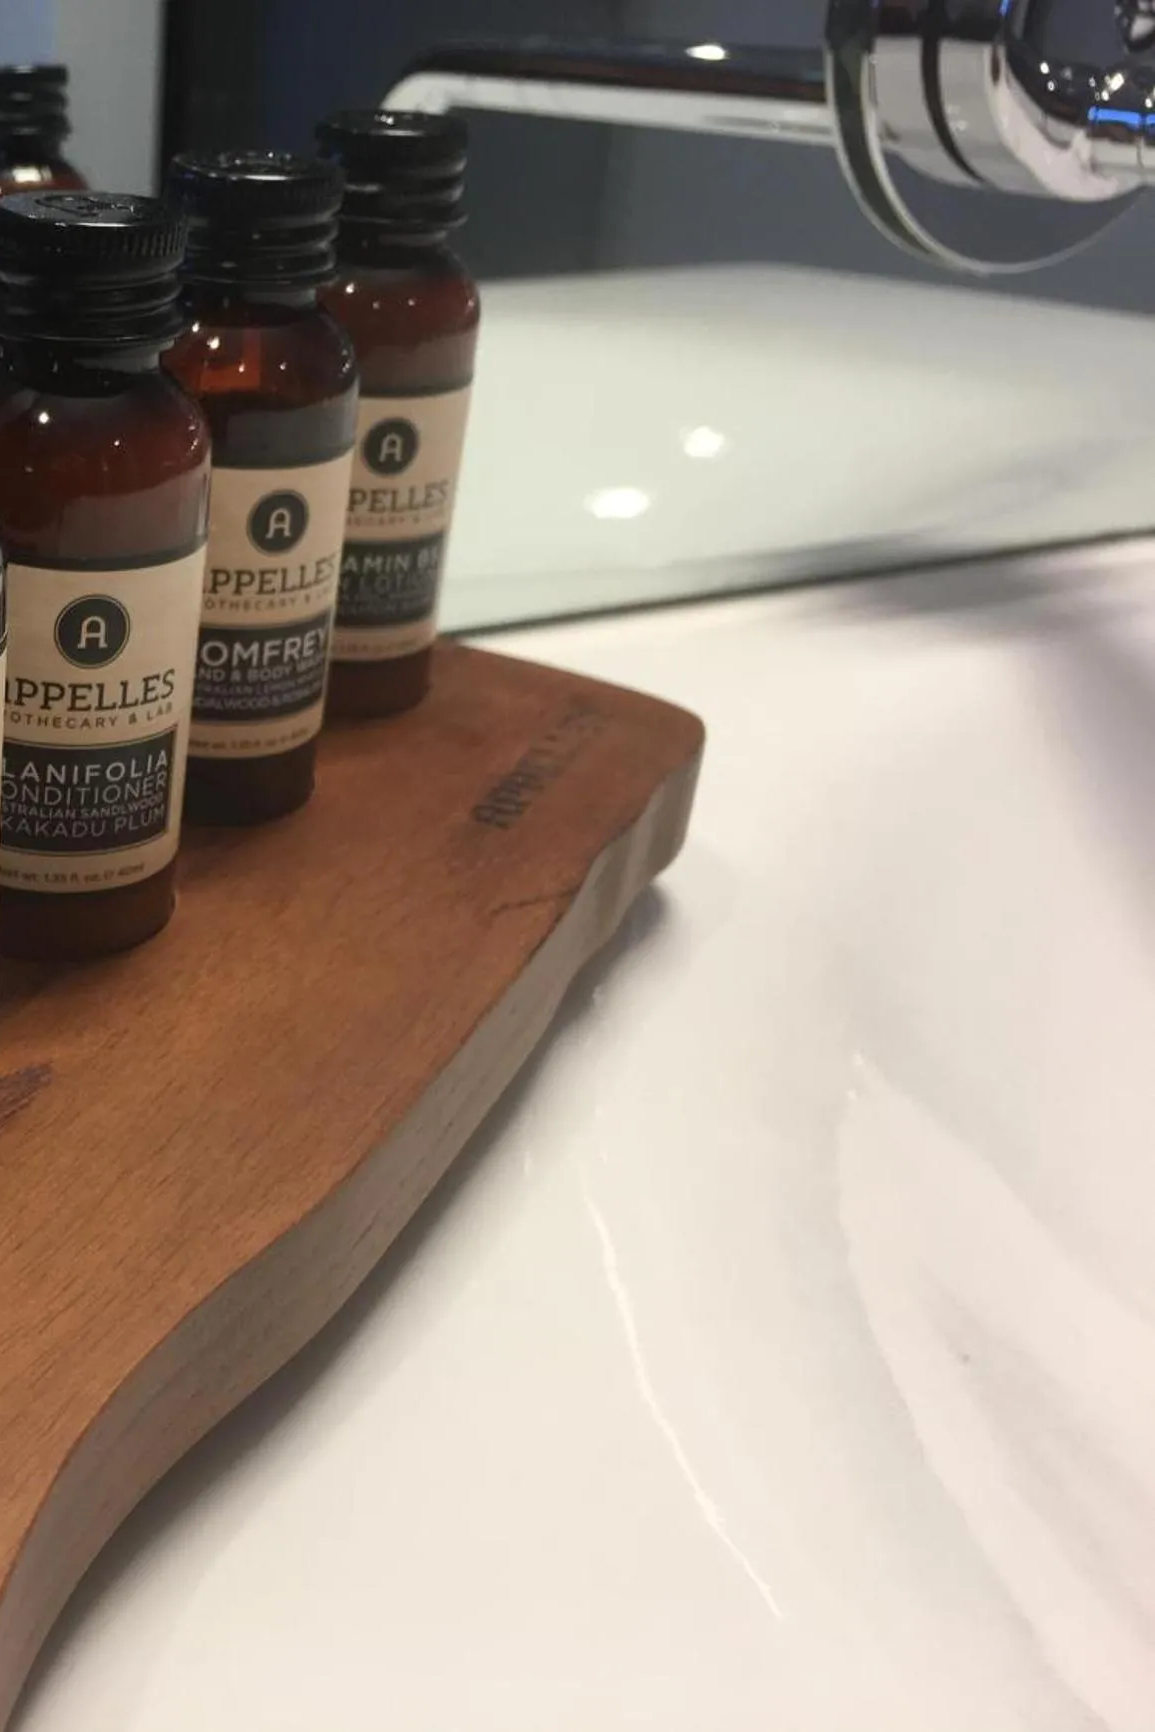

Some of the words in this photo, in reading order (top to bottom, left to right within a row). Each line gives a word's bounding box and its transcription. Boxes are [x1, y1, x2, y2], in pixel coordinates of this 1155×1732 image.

[346, 480, 449, 513] PELLES
[266, 507, 292, 538] A
[202, 554, 336, 595] PPELLES
[344, 553, 410, 574] AMIN
[204, 596, 296, 612] OTHECARY
[77, 616, 107, 649] A
[200, 627, 327, 667] OMFREY
[5, 711, 119, 731] OTHECARY
[3, 750, 169, 786] LANIFOLIA
[1, 771, 168, 807] ONDITIONER
[2, 802, 77, 820] STRALIAN
[114, 804, 166, 834] PLUM
